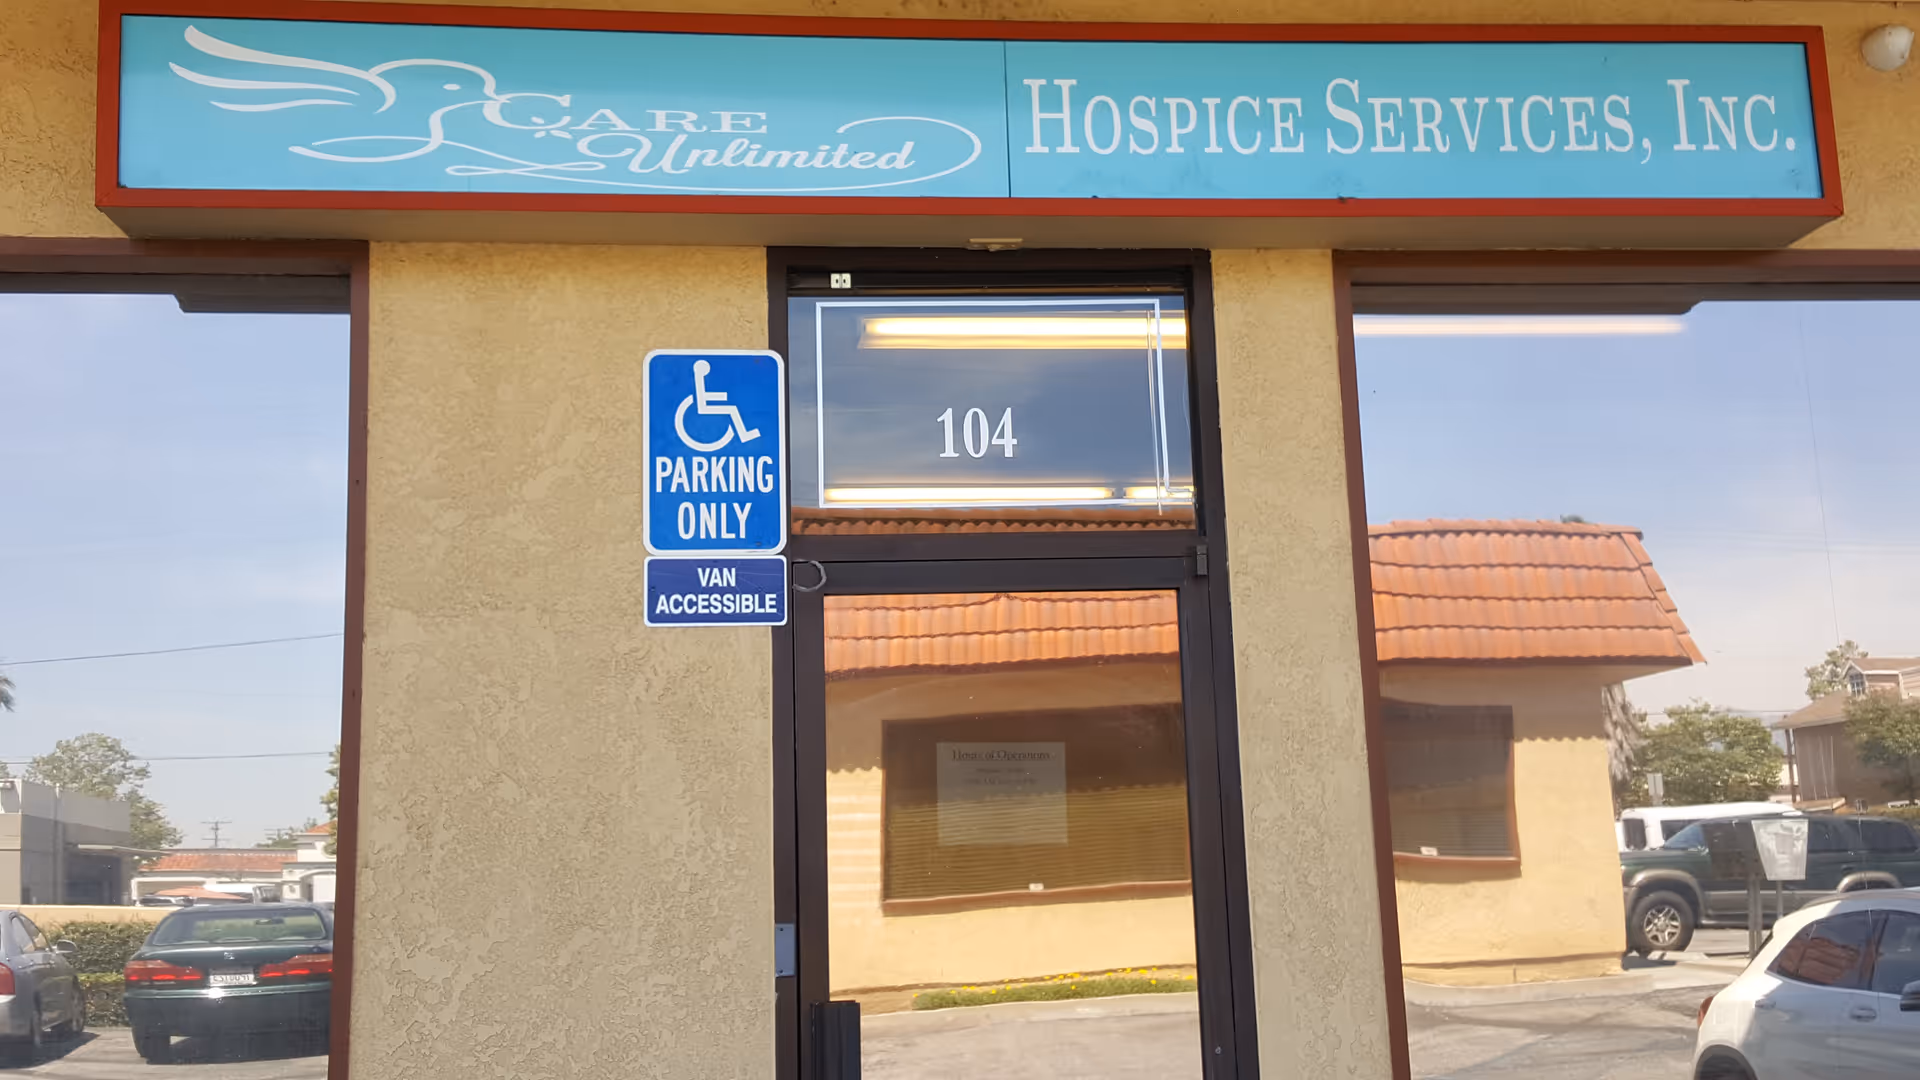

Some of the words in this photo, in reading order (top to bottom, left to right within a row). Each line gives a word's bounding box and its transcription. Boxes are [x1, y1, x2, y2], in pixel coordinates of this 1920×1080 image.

[483, 92, 768, 133] CARE
[1023, 78, 1304, 154] HOSPICE
[1326, 78, 1652, 165] SERVICES,
[1667, 79, 1798, 152] INC.
[577, 133, 915, 174] Unlimited
[936, 407, 1018, 458] 104
[655, 456, 774, 493] PARKING
[677, 501, 752, 540] ONLY
[697, 567, 736, 587] VAN
[655, 593, 777, 614] ACCESSIBLE
